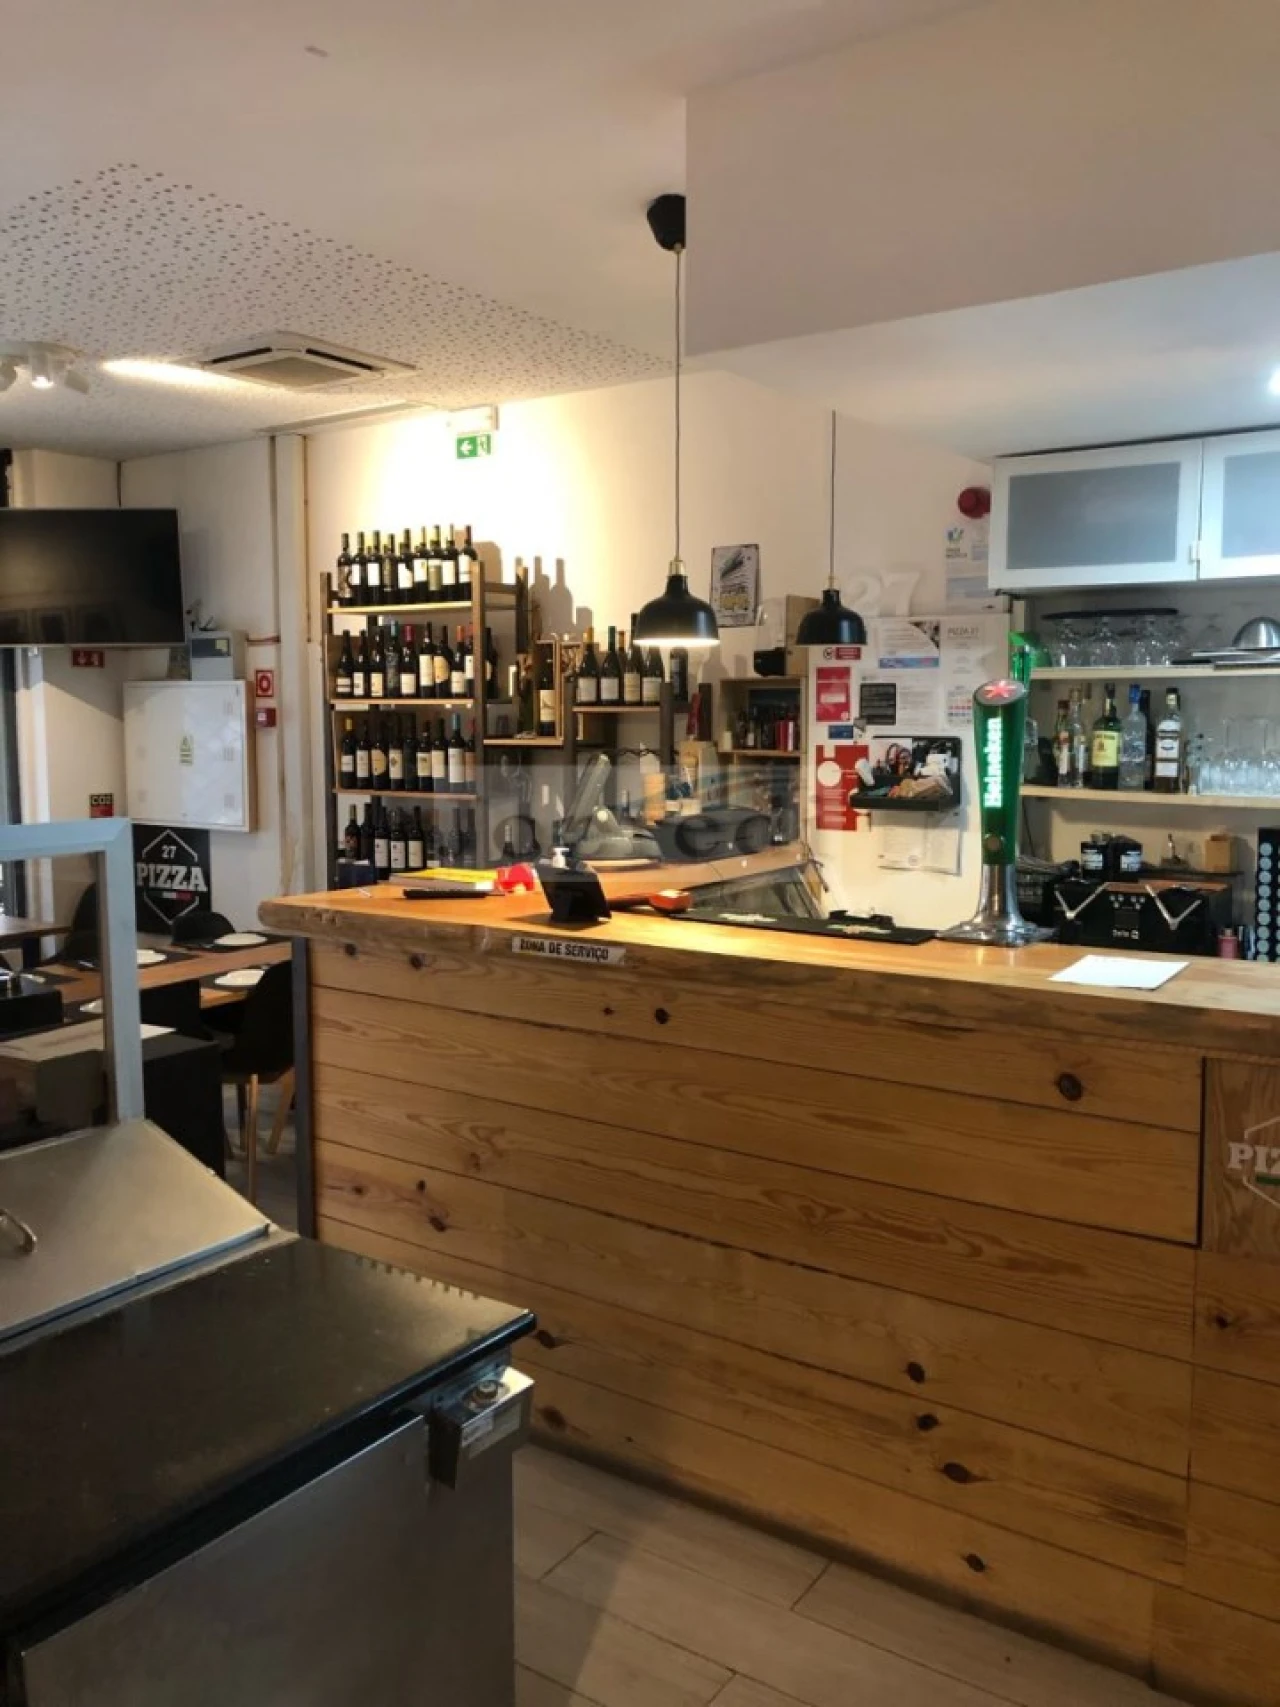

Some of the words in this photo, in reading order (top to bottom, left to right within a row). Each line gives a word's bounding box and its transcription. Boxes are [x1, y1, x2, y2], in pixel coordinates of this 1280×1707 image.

[845, 570, 920, 617] 27
[982, 717, 1002, 807] Heineken
[161, 845, 178, 859] 27
[136, 862, 208, 891] PIZZA
[520, 938, 545, 953] ZONA
[548, 941, 563, 956] DE
[564, 943, 608, 962] SERVIÇO
